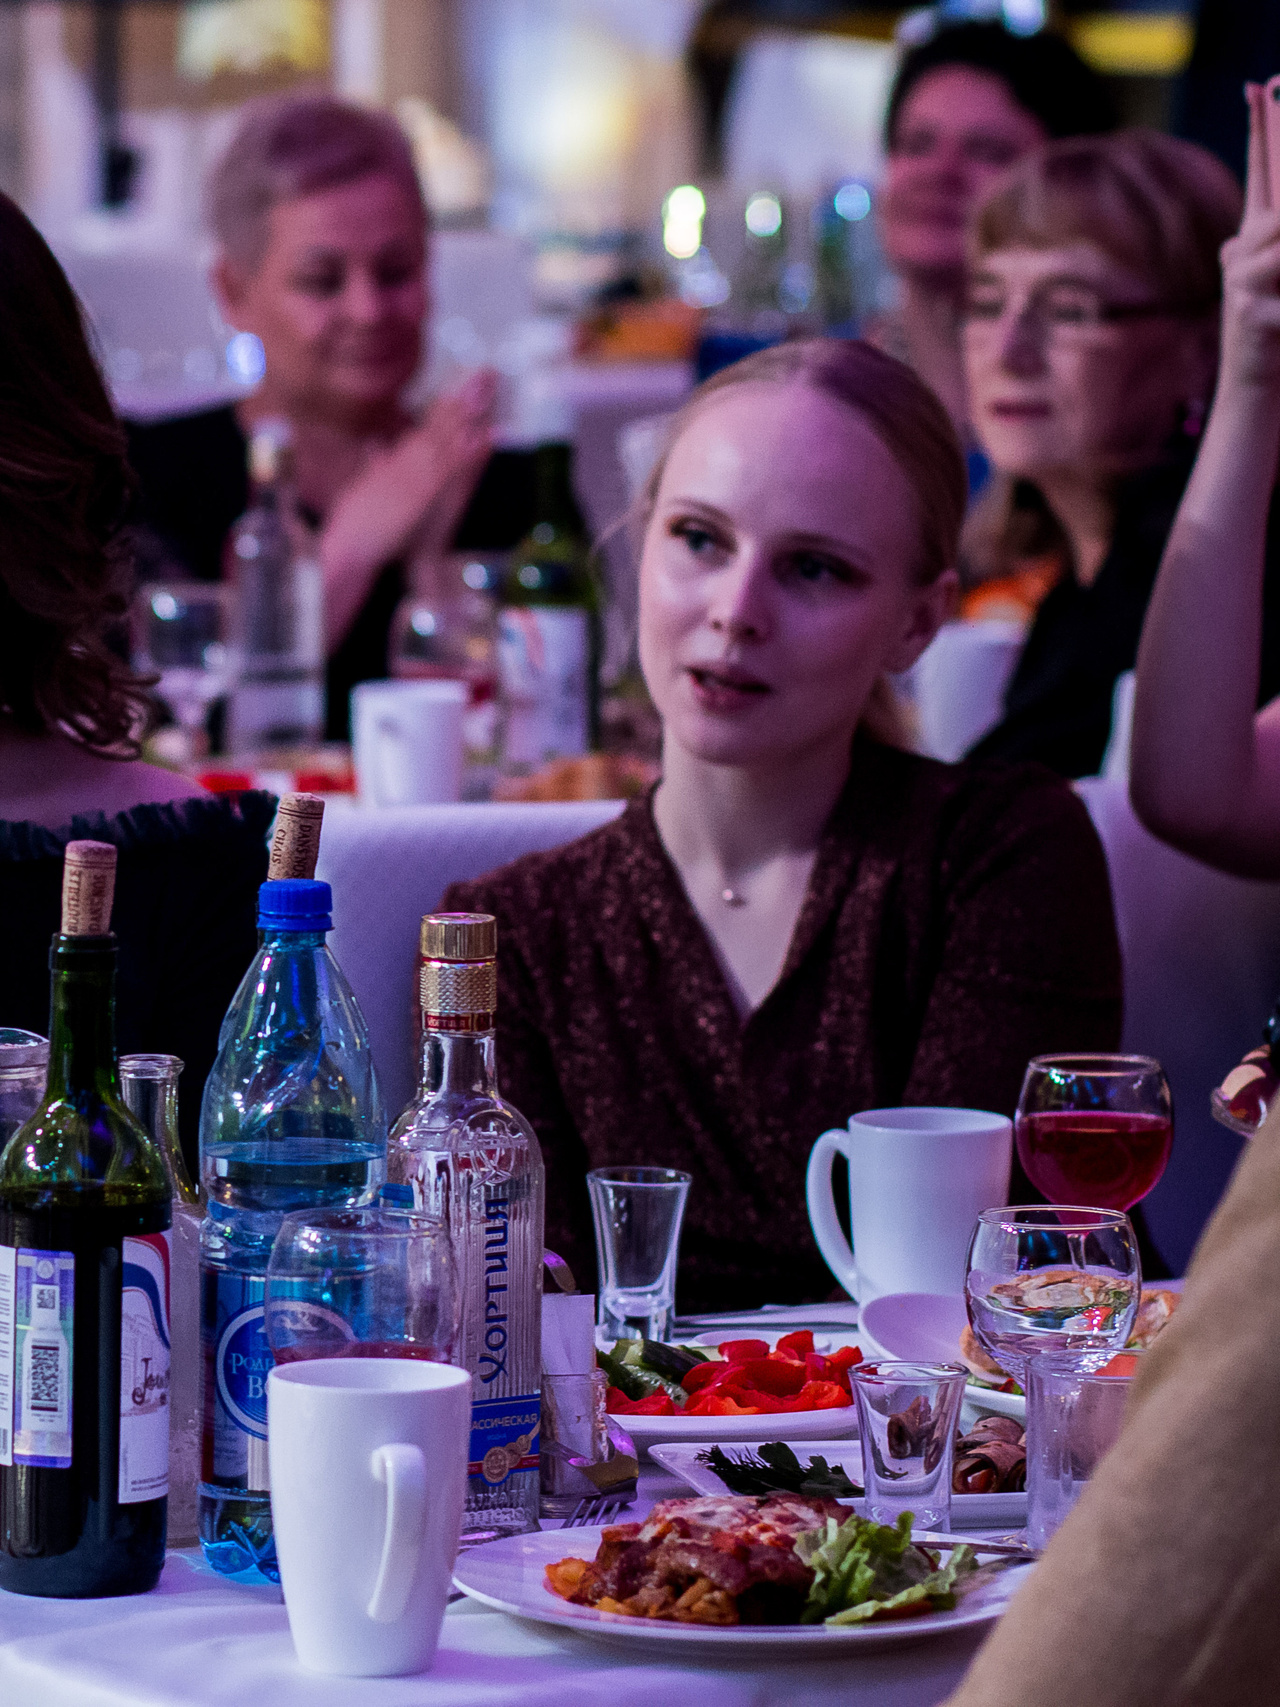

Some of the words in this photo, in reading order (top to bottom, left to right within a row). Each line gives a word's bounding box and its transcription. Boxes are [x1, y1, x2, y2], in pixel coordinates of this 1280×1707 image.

[271, 828, 287, 865] CHAIS
[295, 824, 313, 853] DANS
[478, 1198, 509, 1384] ХОРТИЦЯ
[231, 1353, 276, 1374] РОДН
[471, 1413, 538, 1430] АССИЧЕСКАЯ
